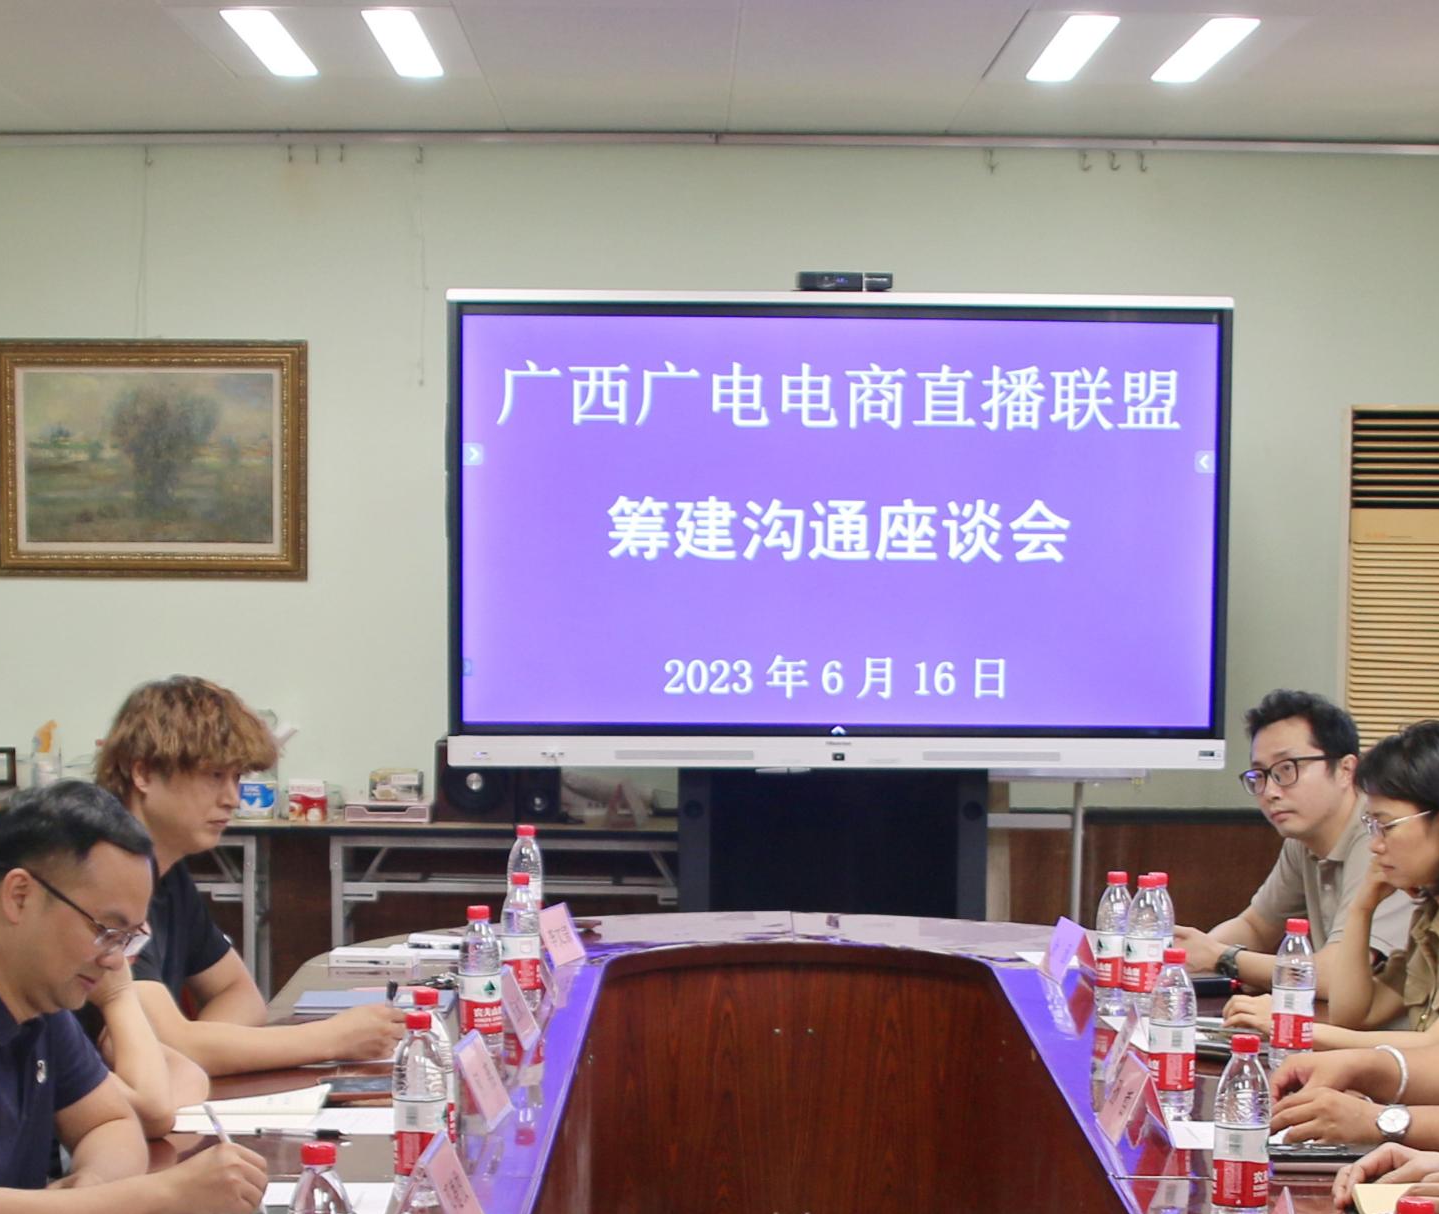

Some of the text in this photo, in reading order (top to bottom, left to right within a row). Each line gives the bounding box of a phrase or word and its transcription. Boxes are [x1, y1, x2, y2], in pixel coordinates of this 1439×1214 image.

[495, 358, 1181, 431] 广西广电电商直播联盟
[606, 494, 1071, 563] 筹建沟通座谈会
[662, 653, 1007, 700] 2023 年 6 月 16 日
